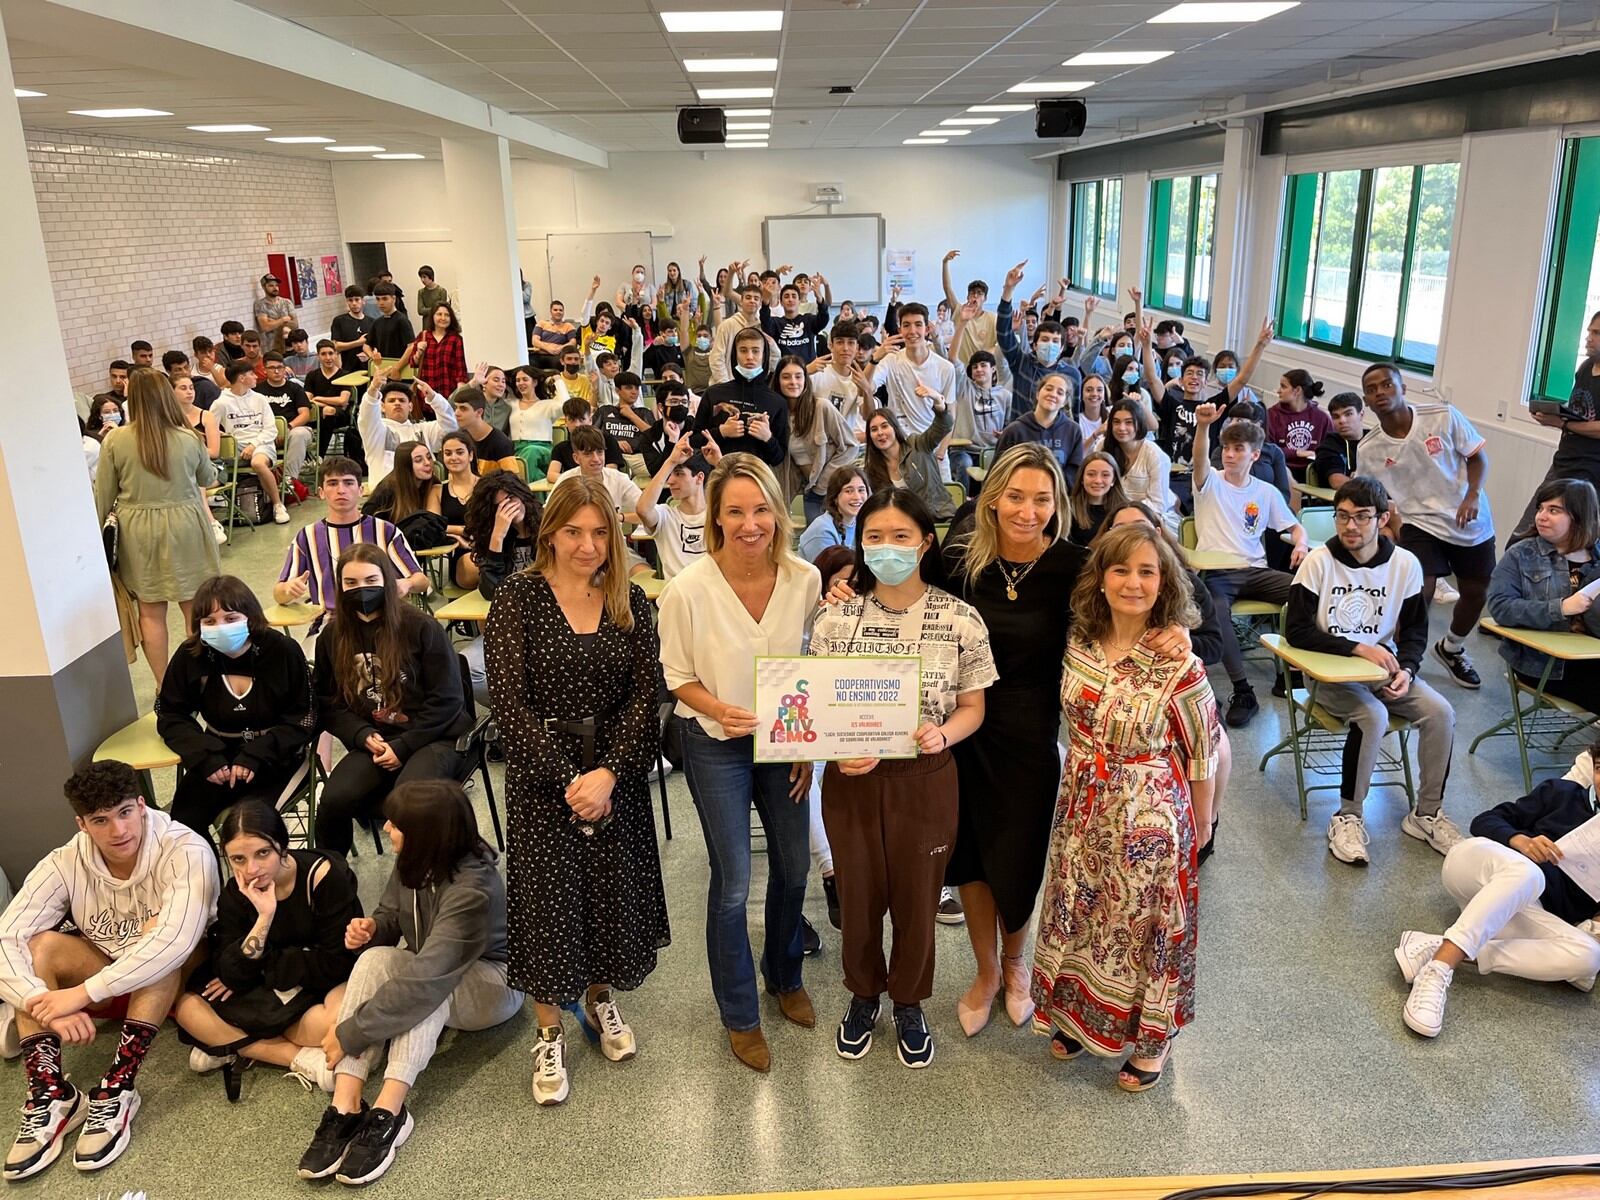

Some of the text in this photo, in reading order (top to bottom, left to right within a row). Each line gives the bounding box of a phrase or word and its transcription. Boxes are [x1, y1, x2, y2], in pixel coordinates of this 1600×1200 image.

[606, 422, 639, 432] Emirates
[834, 679, 901, 690] COOPERATIVISMO
[836, 691, 899, 701] NO ENSINO 2022
[778, 707, 809, 720] PER
[772, 719, 814, 732] ATIV
[770, 730, 817, 743] ISMO
